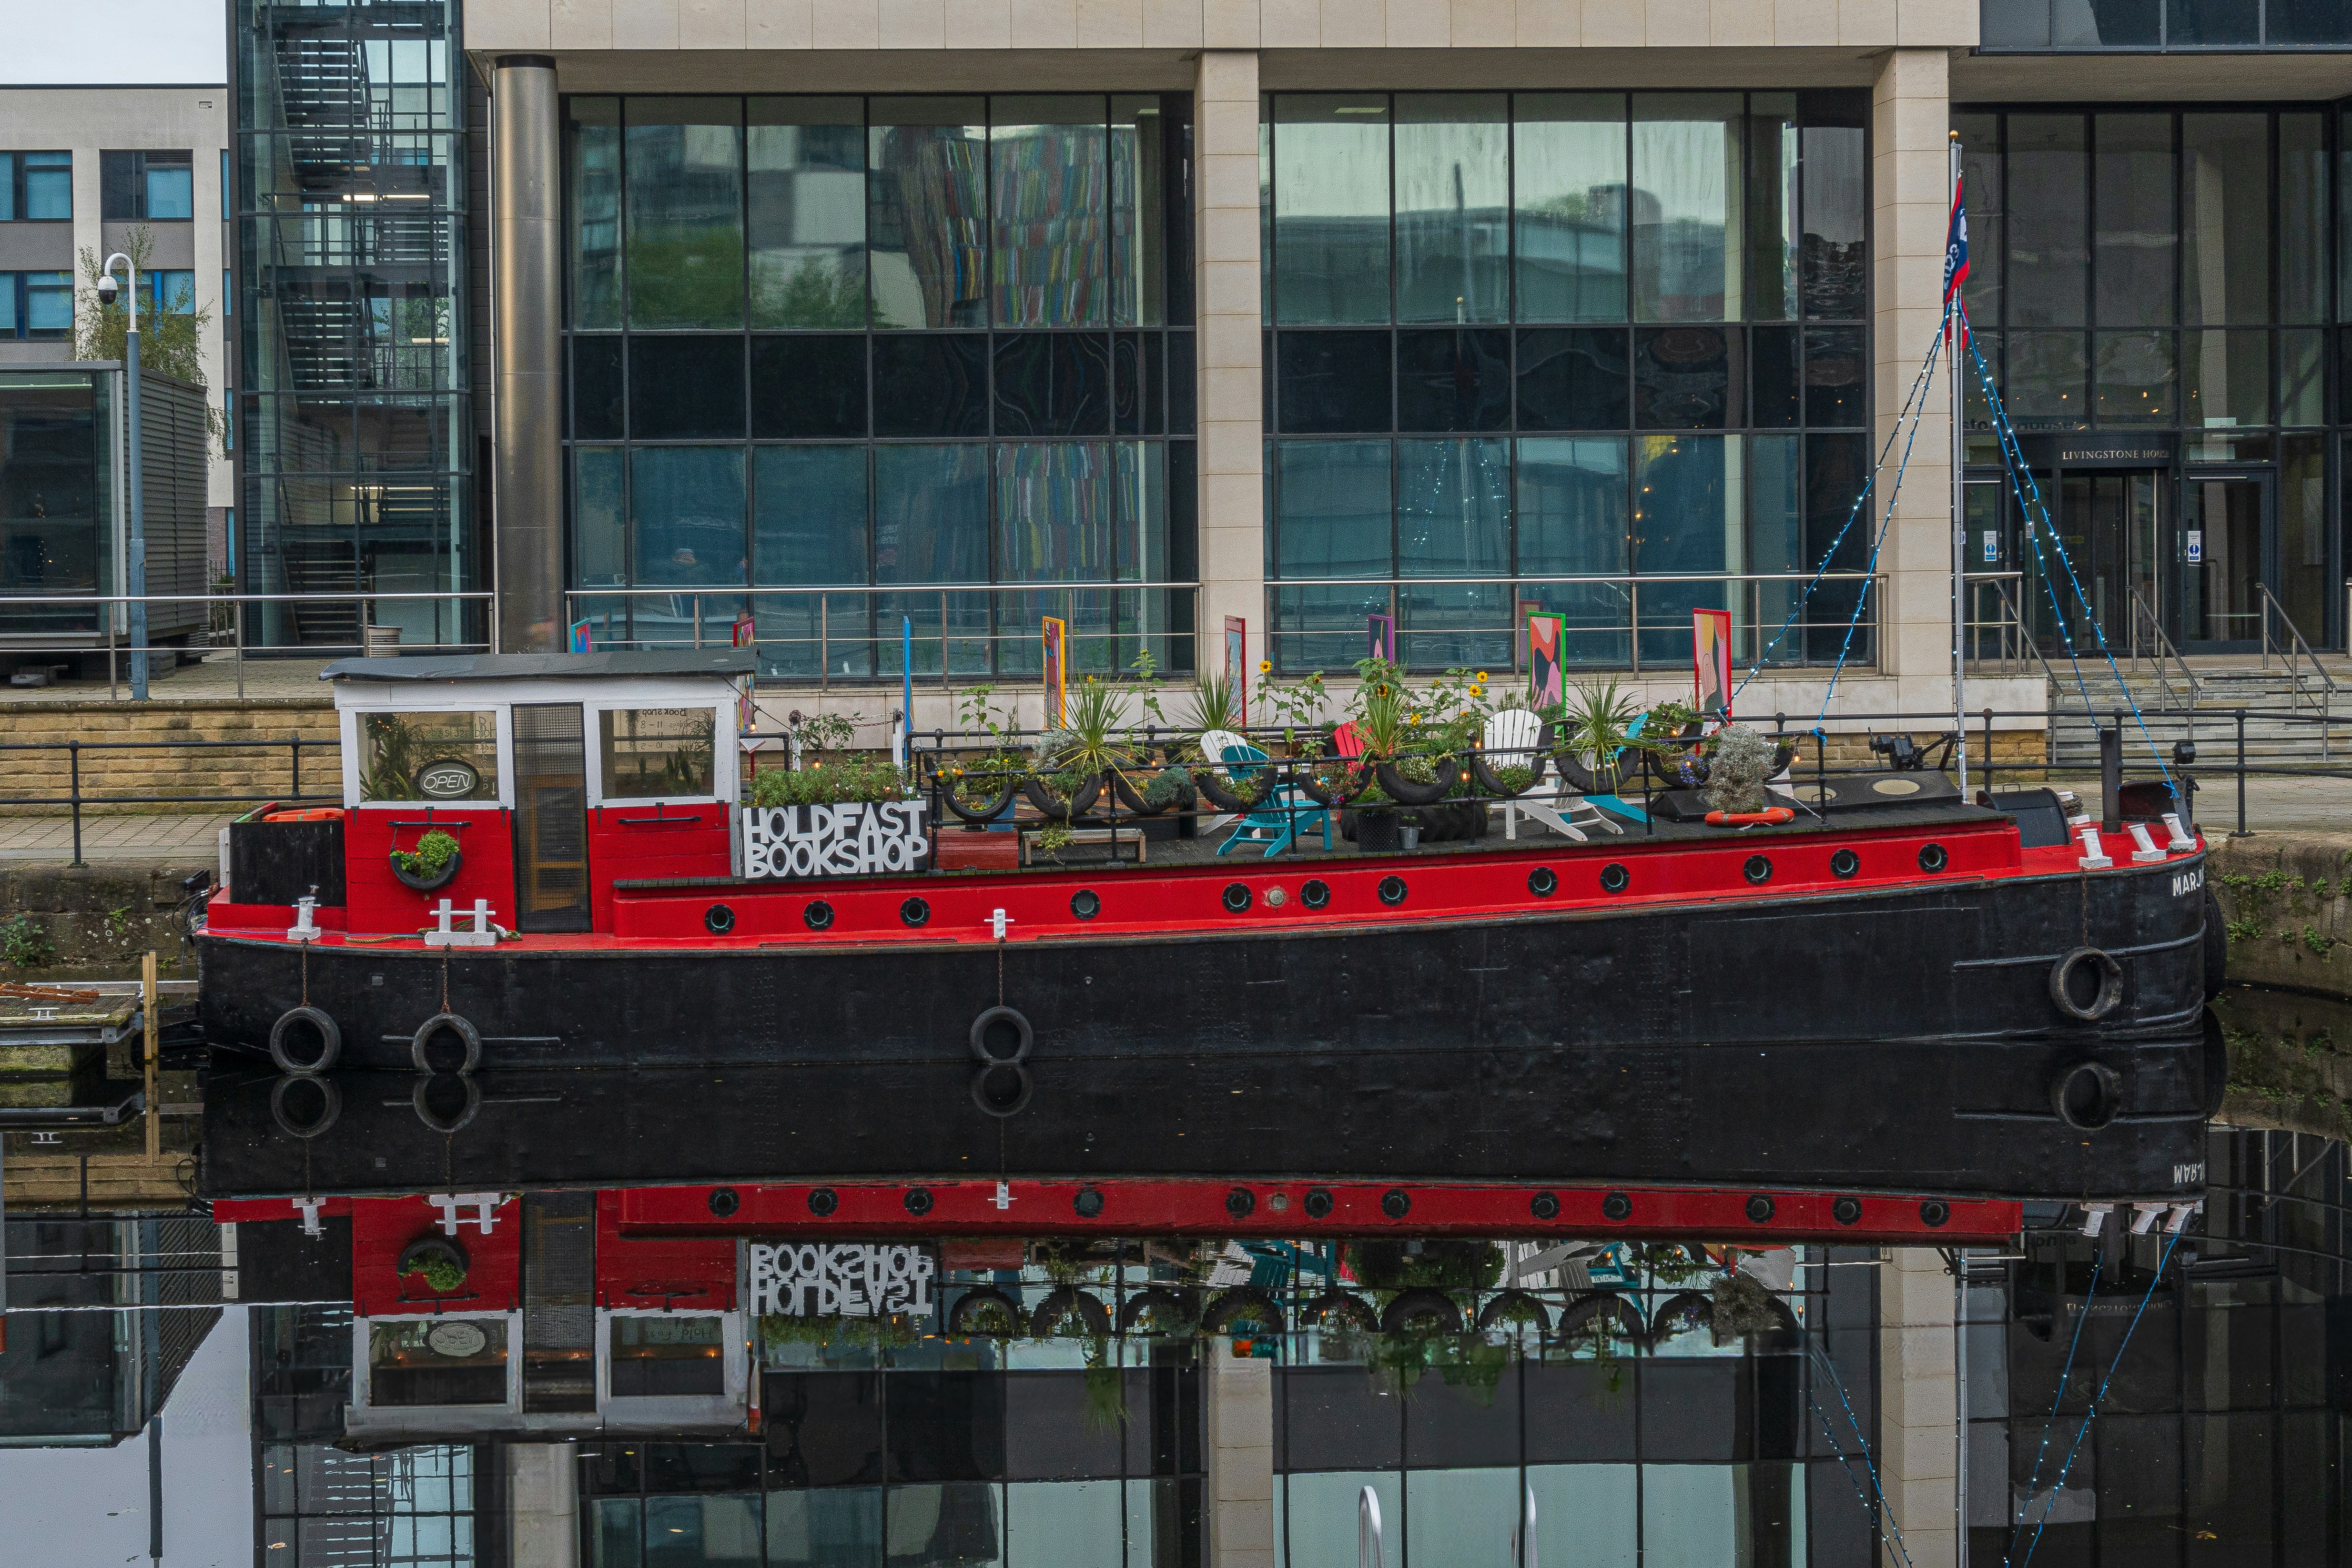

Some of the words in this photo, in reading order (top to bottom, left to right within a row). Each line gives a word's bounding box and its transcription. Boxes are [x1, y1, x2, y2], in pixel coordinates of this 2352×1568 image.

[2063, 450, 2139, 460] LIVINGSTONE
[2142, 449, 2170, 458] HOUSE
[423, 775, 471, 789] OPEN
[742, 800, 927, 843] HOLDFAST
[744, 835, 928, 879] BOOKSHOP
[2173, 868, 2204, 896] MARJ
